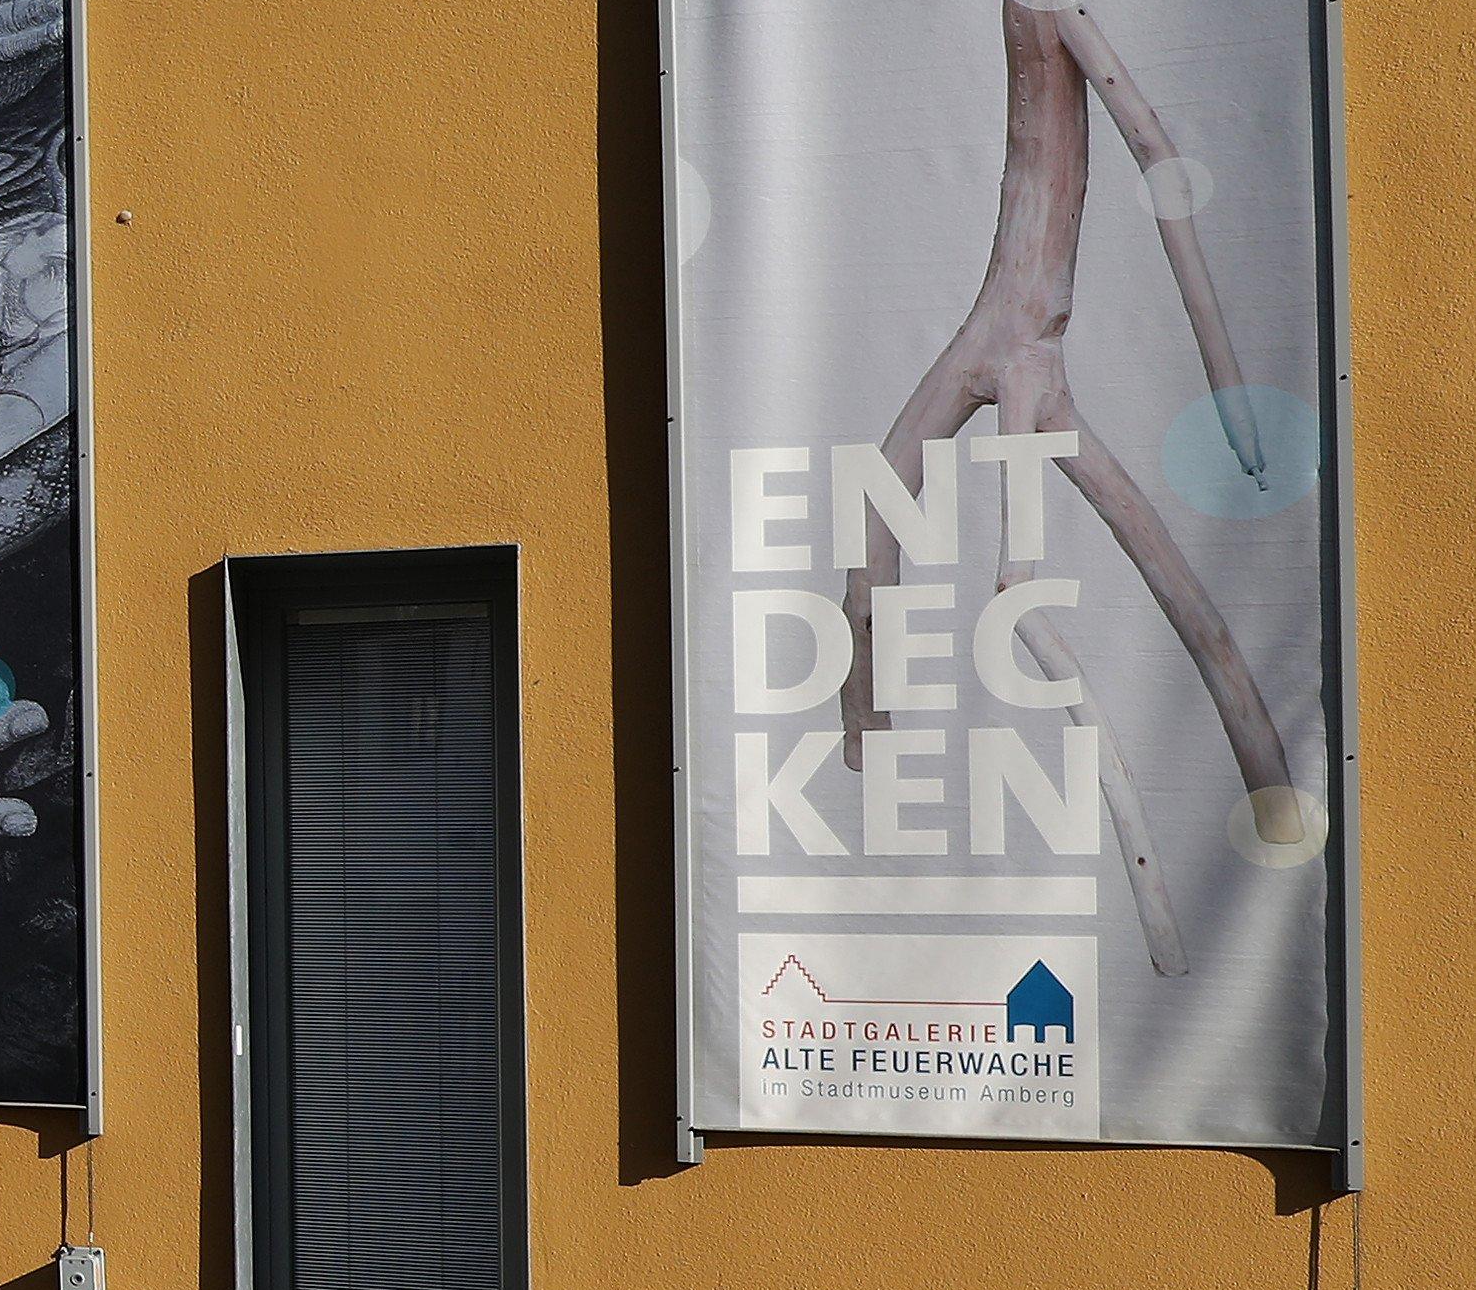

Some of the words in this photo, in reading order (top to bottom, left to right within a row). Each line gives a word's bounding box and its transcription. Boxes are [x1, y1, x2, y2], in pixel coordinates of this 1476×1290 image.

[729, 430, 1080, 572] ENT
[731, 579, 1086, 714] DEC
[735, 726, 1101, 857] KEN
[761, 1020, 997, 1043] STADTGALERIE
[762, 1047, 836, 1073] ALTE
[852, 1049, 1075, 1078] FEUERWACHE
[762, 1079, 788, 1096] im
[800, 1079, 967, 1101] Stadtmuseum
[980, 1085, 1075, 1108] Amberg
